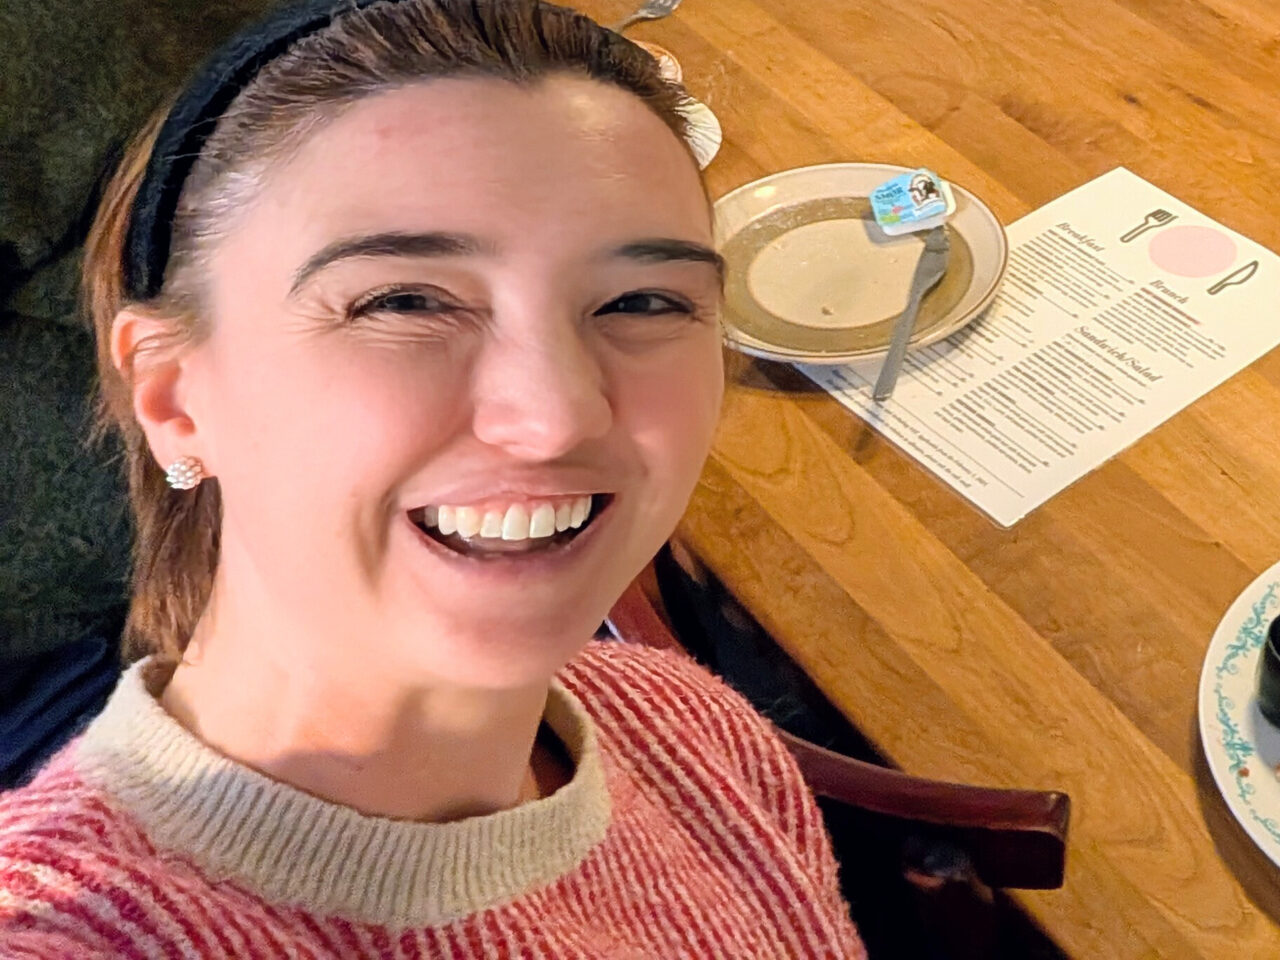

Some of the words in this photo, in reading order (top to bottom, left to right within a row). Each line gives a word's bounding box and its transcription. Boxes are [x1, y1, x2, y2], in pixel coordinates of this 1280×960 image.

[1056, 222, 1106, 252] Breakfast
[1149, 279, 1190, 304] Brunch
[1073, 326, 1164, 382] Sandwich/Salad
